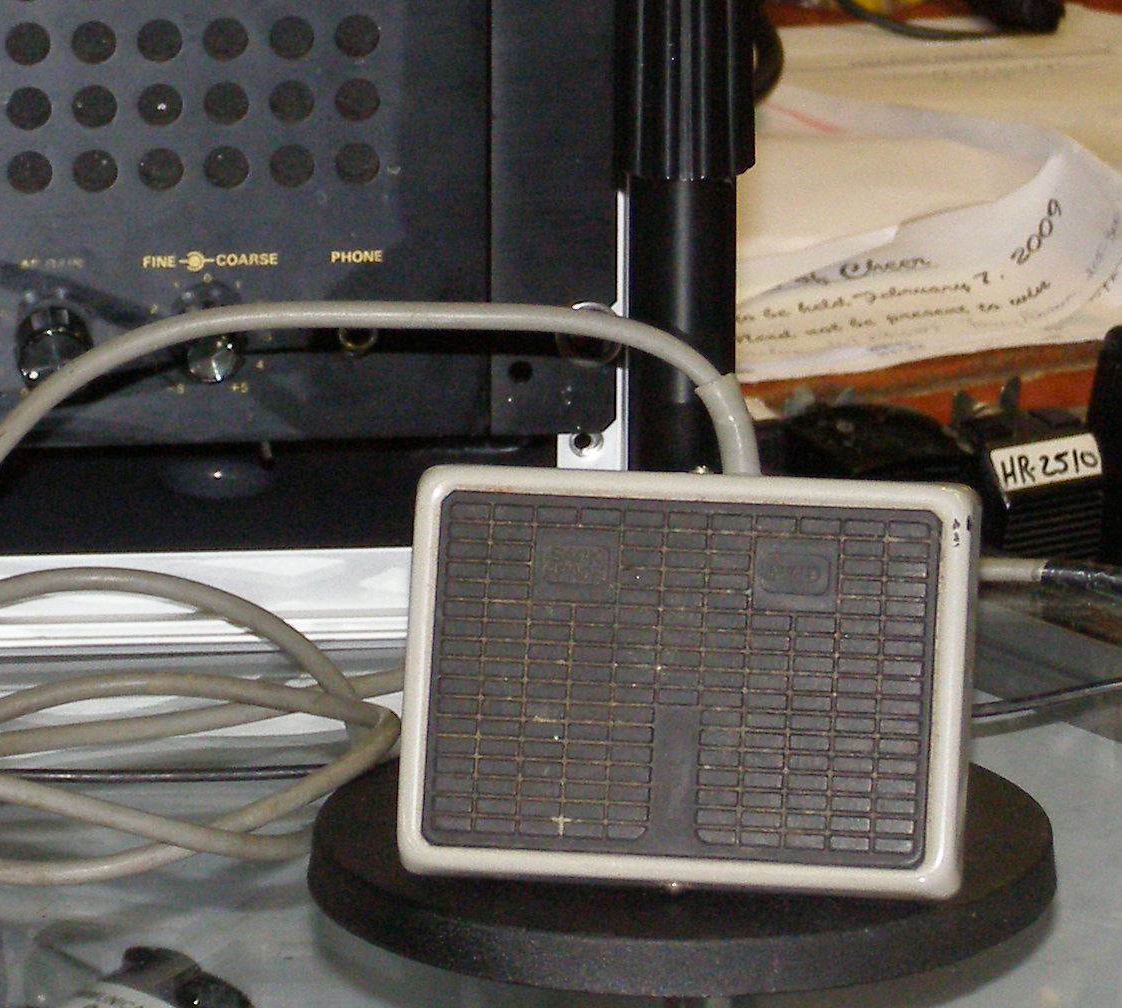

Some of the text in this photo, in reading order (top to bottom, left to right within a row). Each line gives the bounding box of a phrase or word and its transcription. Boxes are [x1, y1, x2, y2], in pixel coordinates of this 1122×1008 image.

[1009, 198, 1062, 266] 2009
[142, 252, 279, 269] FINE COARSE
[331, 249, 384, 264] PHONE
[1000, 448, 1099, 486] HR-2510
